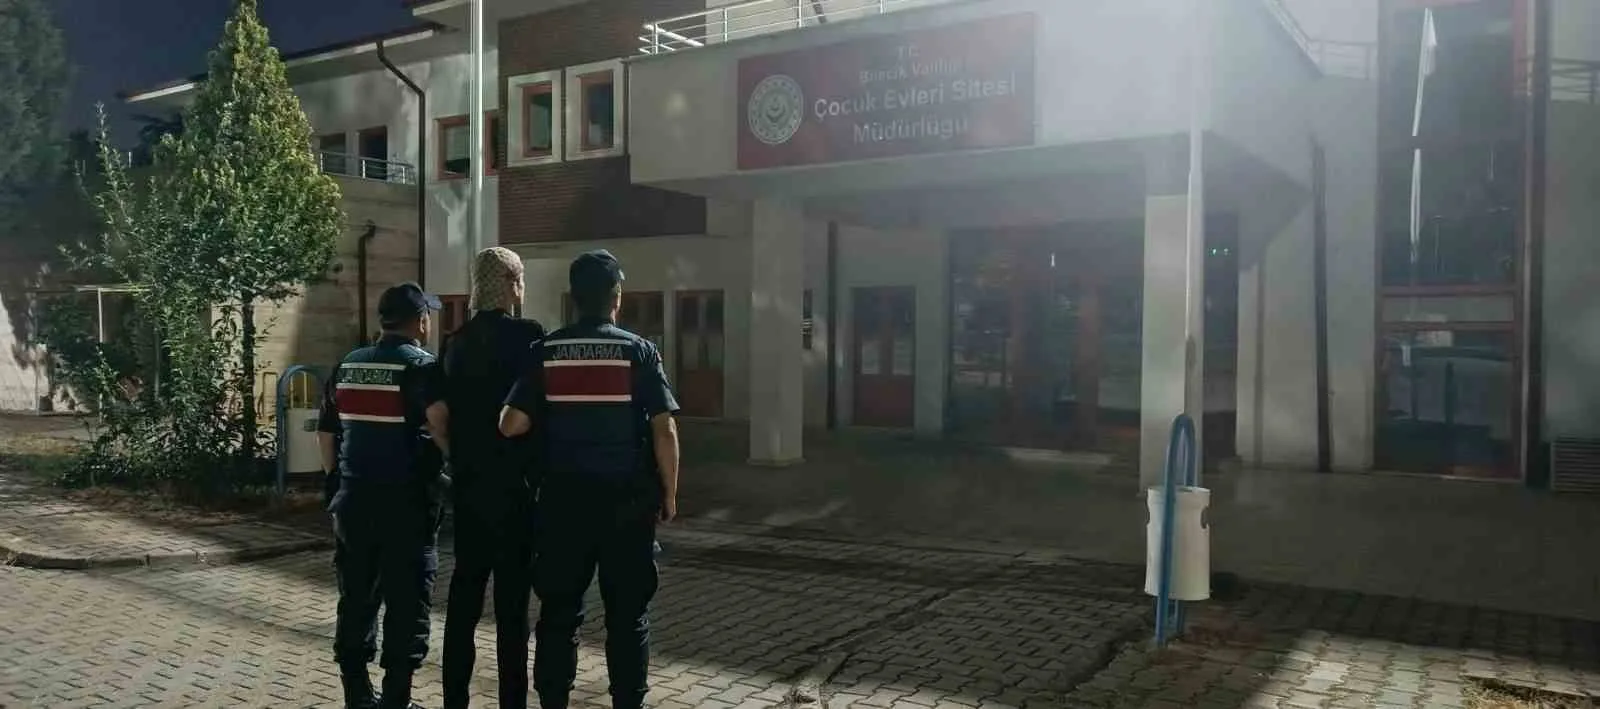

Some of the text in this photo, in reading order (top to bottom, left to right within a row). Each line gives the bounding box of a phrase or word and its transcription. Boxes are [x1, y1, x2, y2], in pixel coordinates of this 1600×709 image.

[814, 72, 1016, 120] Çocuk Evleri Sitesi
[552, 344, 623, 361] JANDARMA
